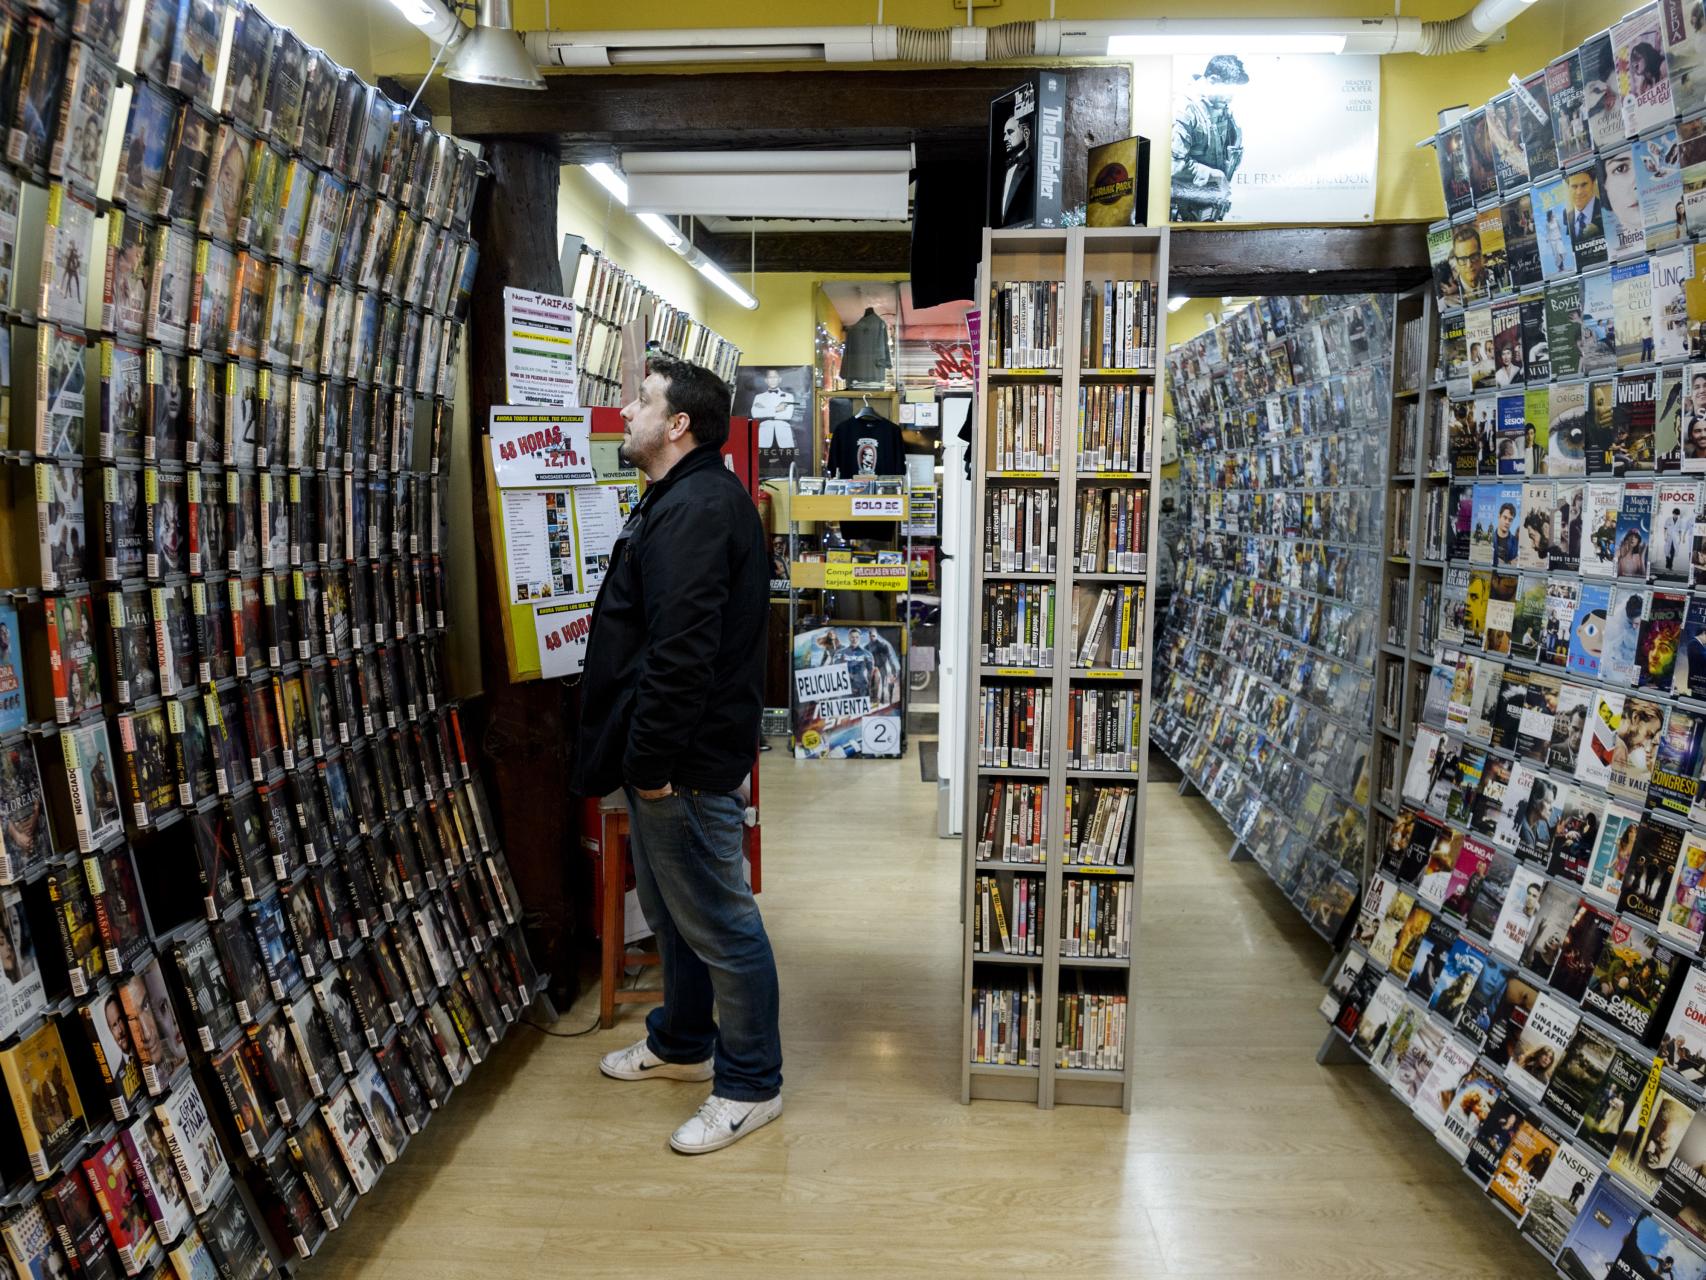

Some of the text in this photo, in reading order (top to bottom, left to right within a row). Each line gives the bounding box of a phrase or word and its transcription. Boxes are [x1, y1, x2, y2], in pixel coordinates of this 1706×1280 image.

[1040, 106, 1063, 200] The Godfather
[1115, 181, 1132, 193] PARK
[1237, 173, 1251, 184] EL
[535, 295, 574, 311] TARIFAS
[500, 425, 562, 461] 48 HORAS
[854, 567, 907, 576] PELICULAS EN VENTA
[826, 579, 851, 588] tarjeta
[869, 580, 901, 588] Prepago
[155, 620, 165, 667] BABADOOK
[545, 630, 562, 651] 48
[798, 670, 849, 697] PELICULAS
[820, 700, 870, 717] EN VENTA
[873, 723, 887, 743] 2
[1552, 751, 1568, 763] The
[1610, 773, 1626, 785] BLUE
[1652, 770, 1698, 796] CONGRESO
[1463, 840, 1484, 857] YOUNG
[1517, 843, 1543, 859] HANNAH
[1371, 878, 1384, 895] LA
[1365, 901, 1381, 914] VITA
[1534, 1012, 1551, 1028] UNA
[1585, 988, 1646, 1036] DESHECHAS
[1611, 994, 1650, 1025] CAMAS
[1531, 1020, 1567, 1049] EN AFRI
[1638, 1062, 1662, 1124] ALQUILADA
[180, 1088, 200, 1122] GRAN
[47, 1117, 76, 1146] Arrugas
[182, 1110, 207, 1143] FINAL
[1444, 1115, 1464, 1140] VAYA
[166, 1133, 192, 1183] GRAN FINAL
[1558, 1150, 1596, 1183] INSIDE
[1673, 1157, 1698, 1177] ALABAMA
[57, 1224, 77, 1258] RETORNO
[1617, 1258, 1630, 1274] NO
